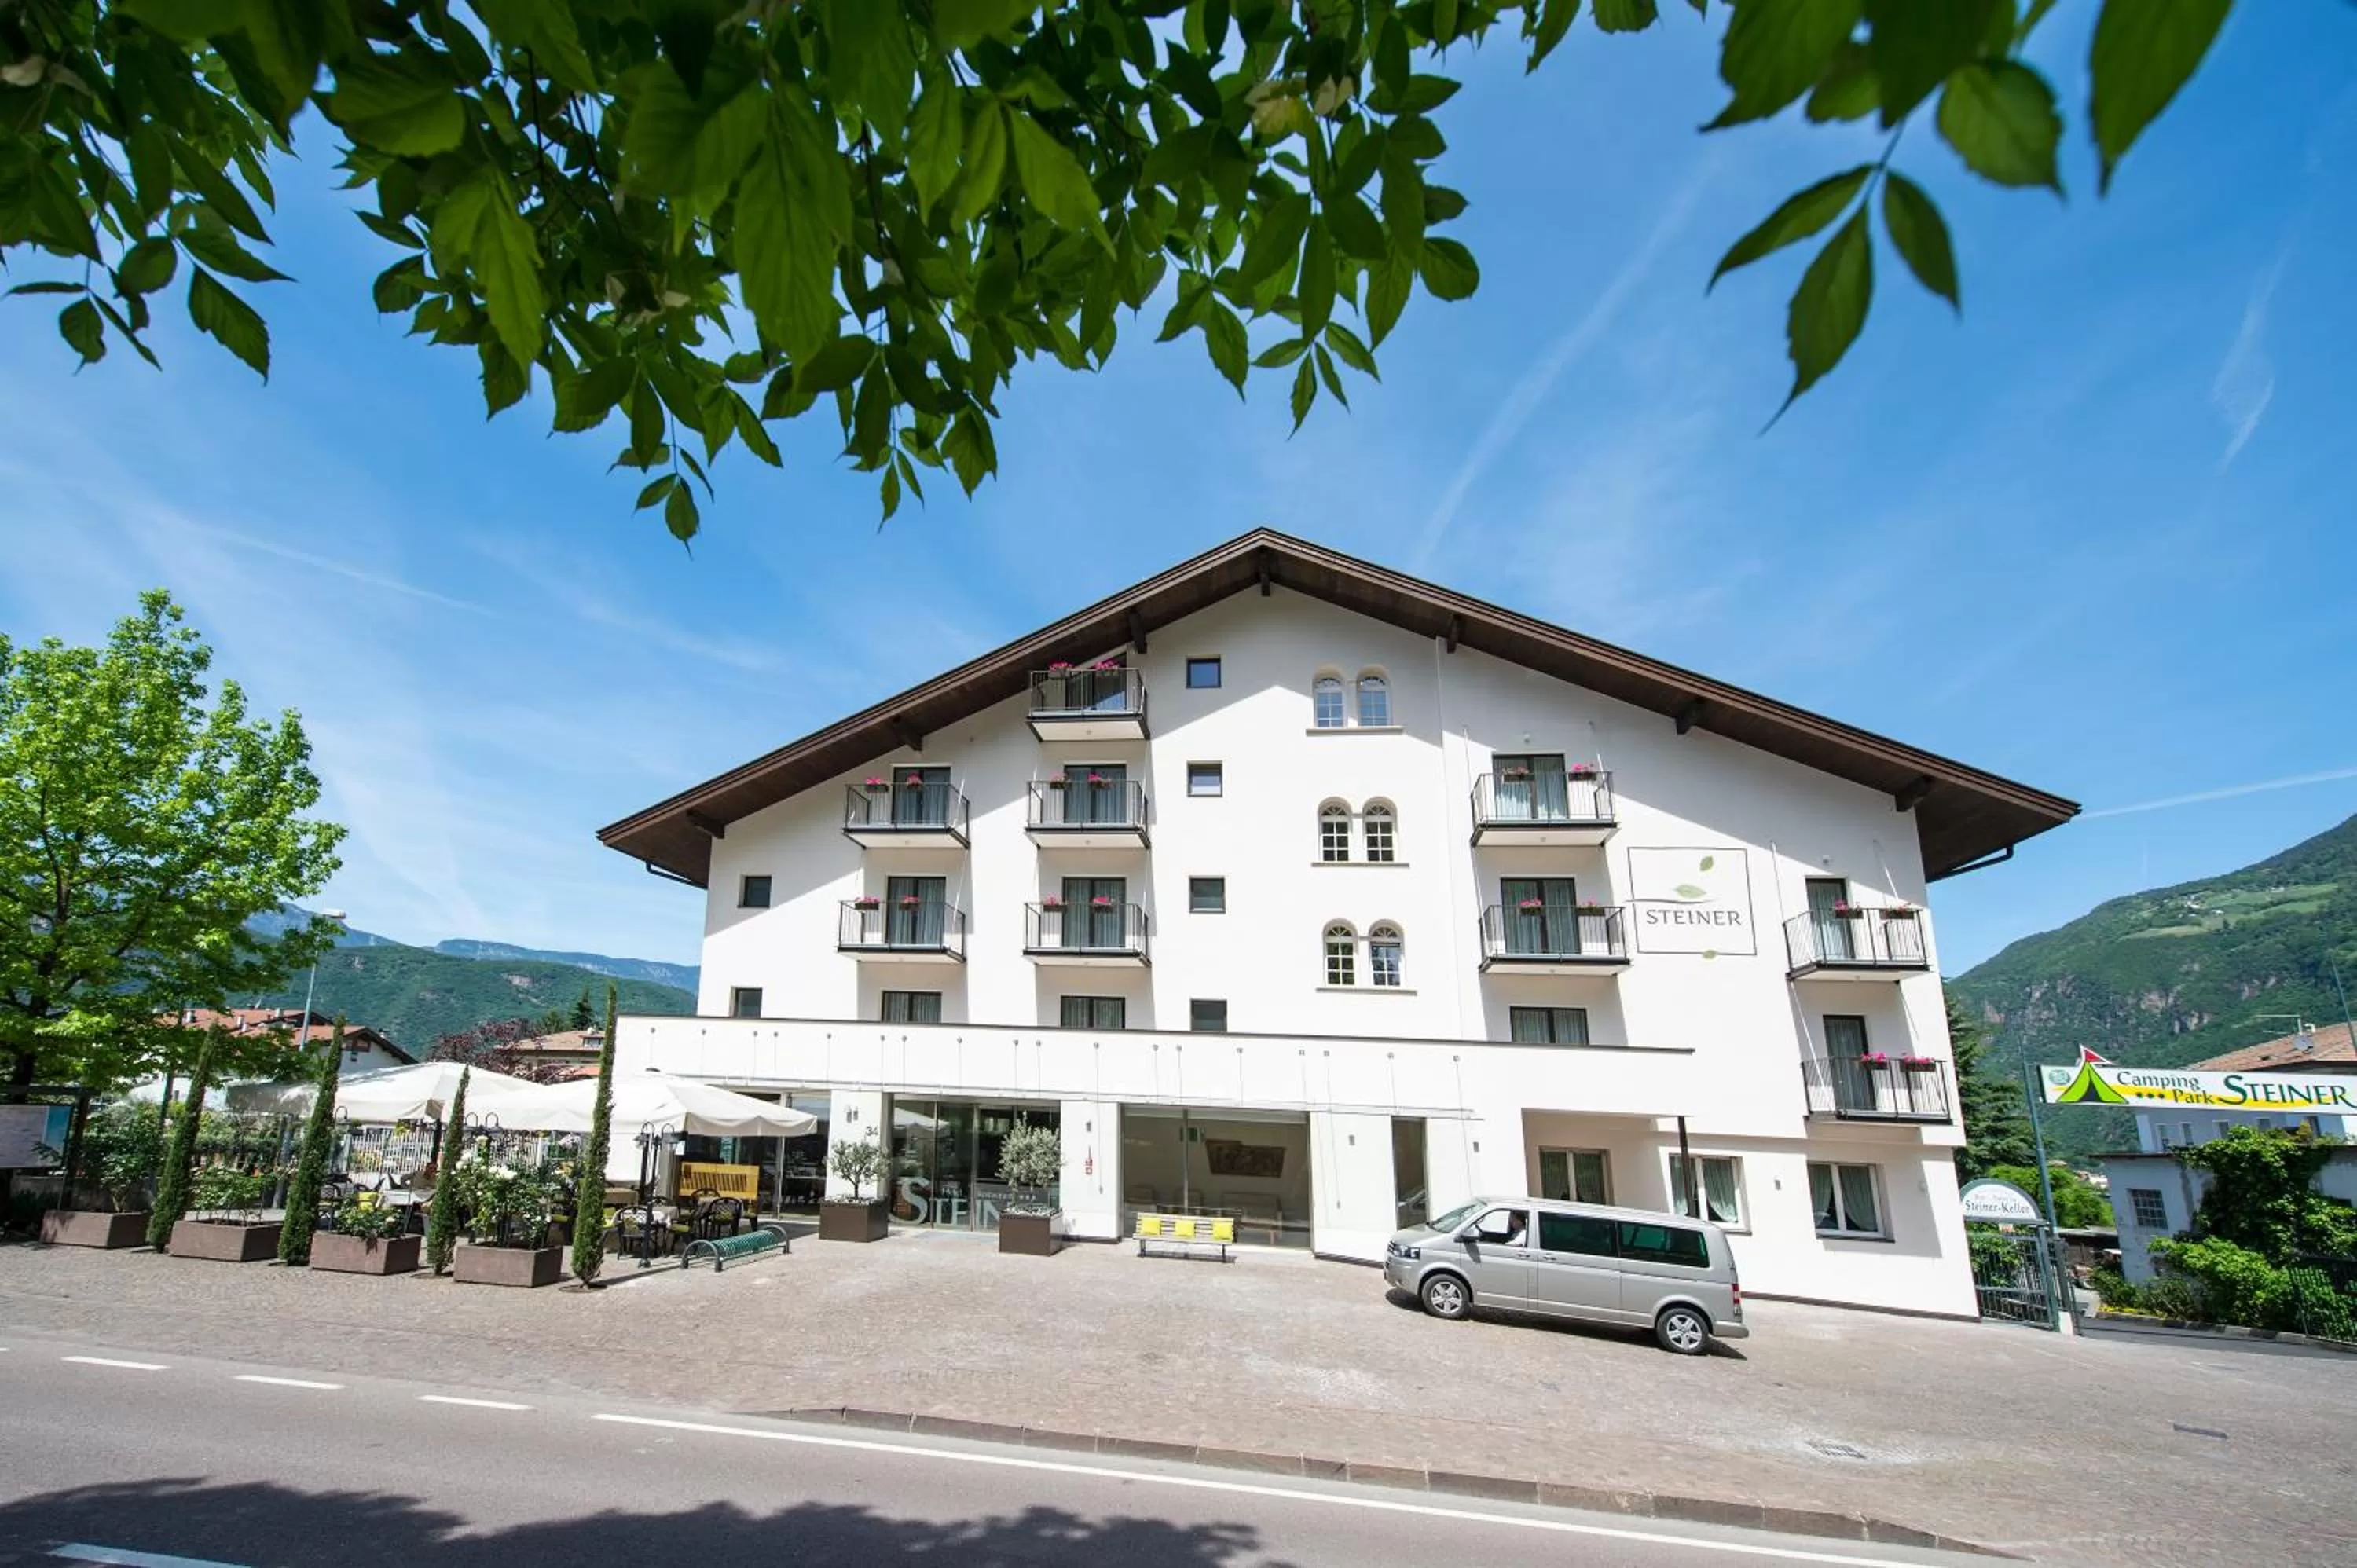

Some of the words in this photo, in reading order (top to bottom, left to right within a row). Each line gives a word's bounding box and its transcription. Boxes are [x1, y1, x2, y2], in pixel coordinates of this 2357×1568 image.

[1646, 909, 1742, 925] STEINER
[2117, 1071, 2200, 1091] Camping
[2172, 1088, 2215, 1104] Park
[2218, 1074, 2357, 1108] STEINER
